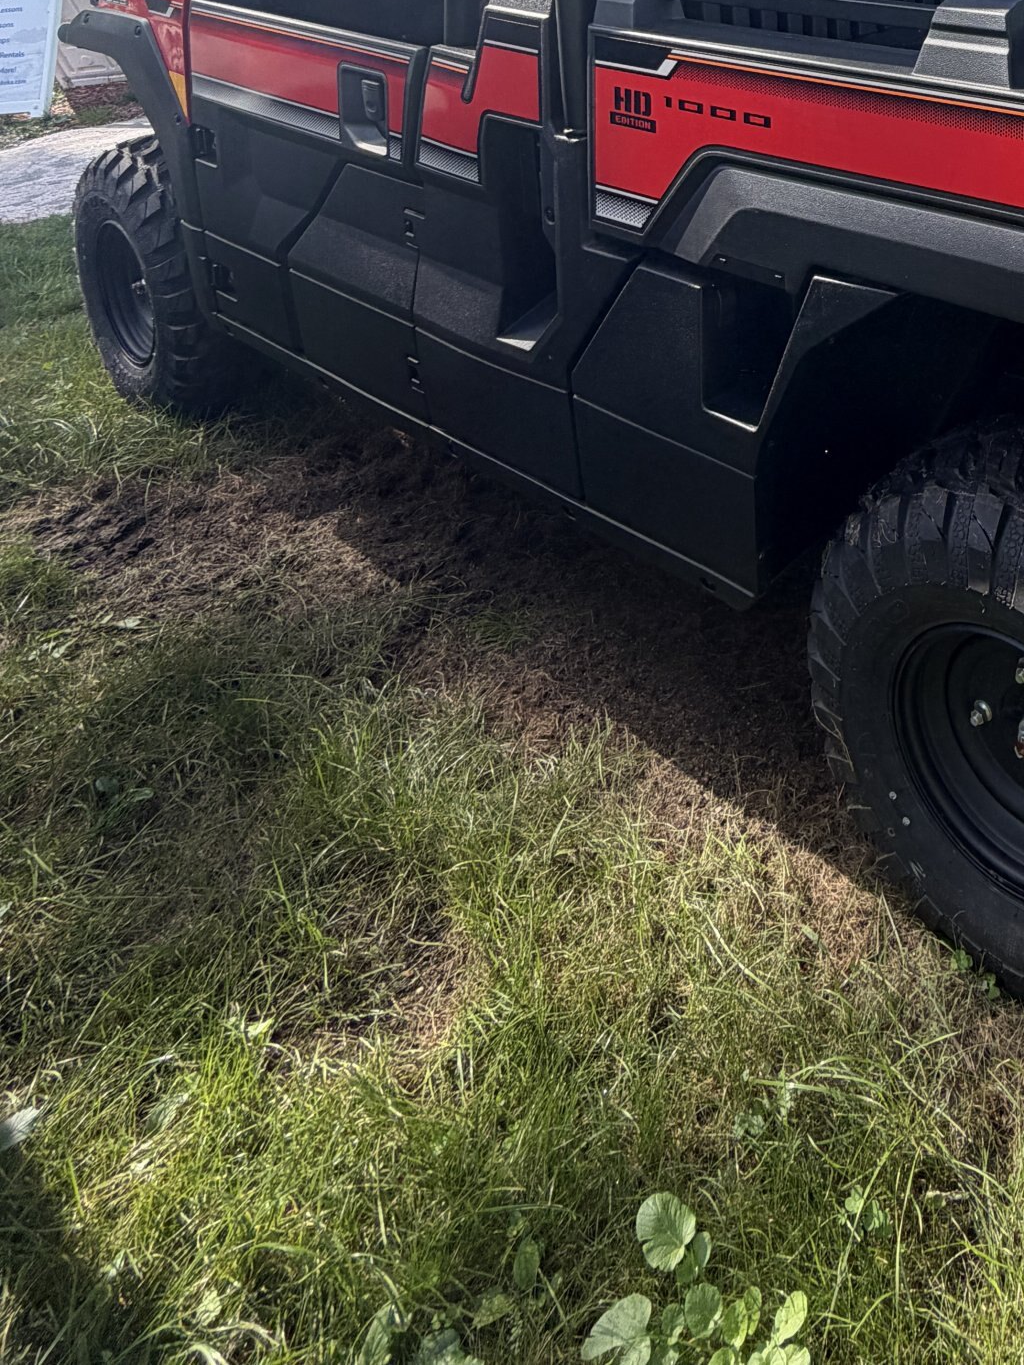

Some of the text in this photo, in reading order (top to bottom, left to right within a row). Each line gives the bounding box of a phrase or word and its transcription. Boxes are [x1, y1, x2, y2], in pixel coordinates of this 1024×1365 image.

[614, 86, 772, 128] HD 1000
[614, 114, 652, 131] EDITION
